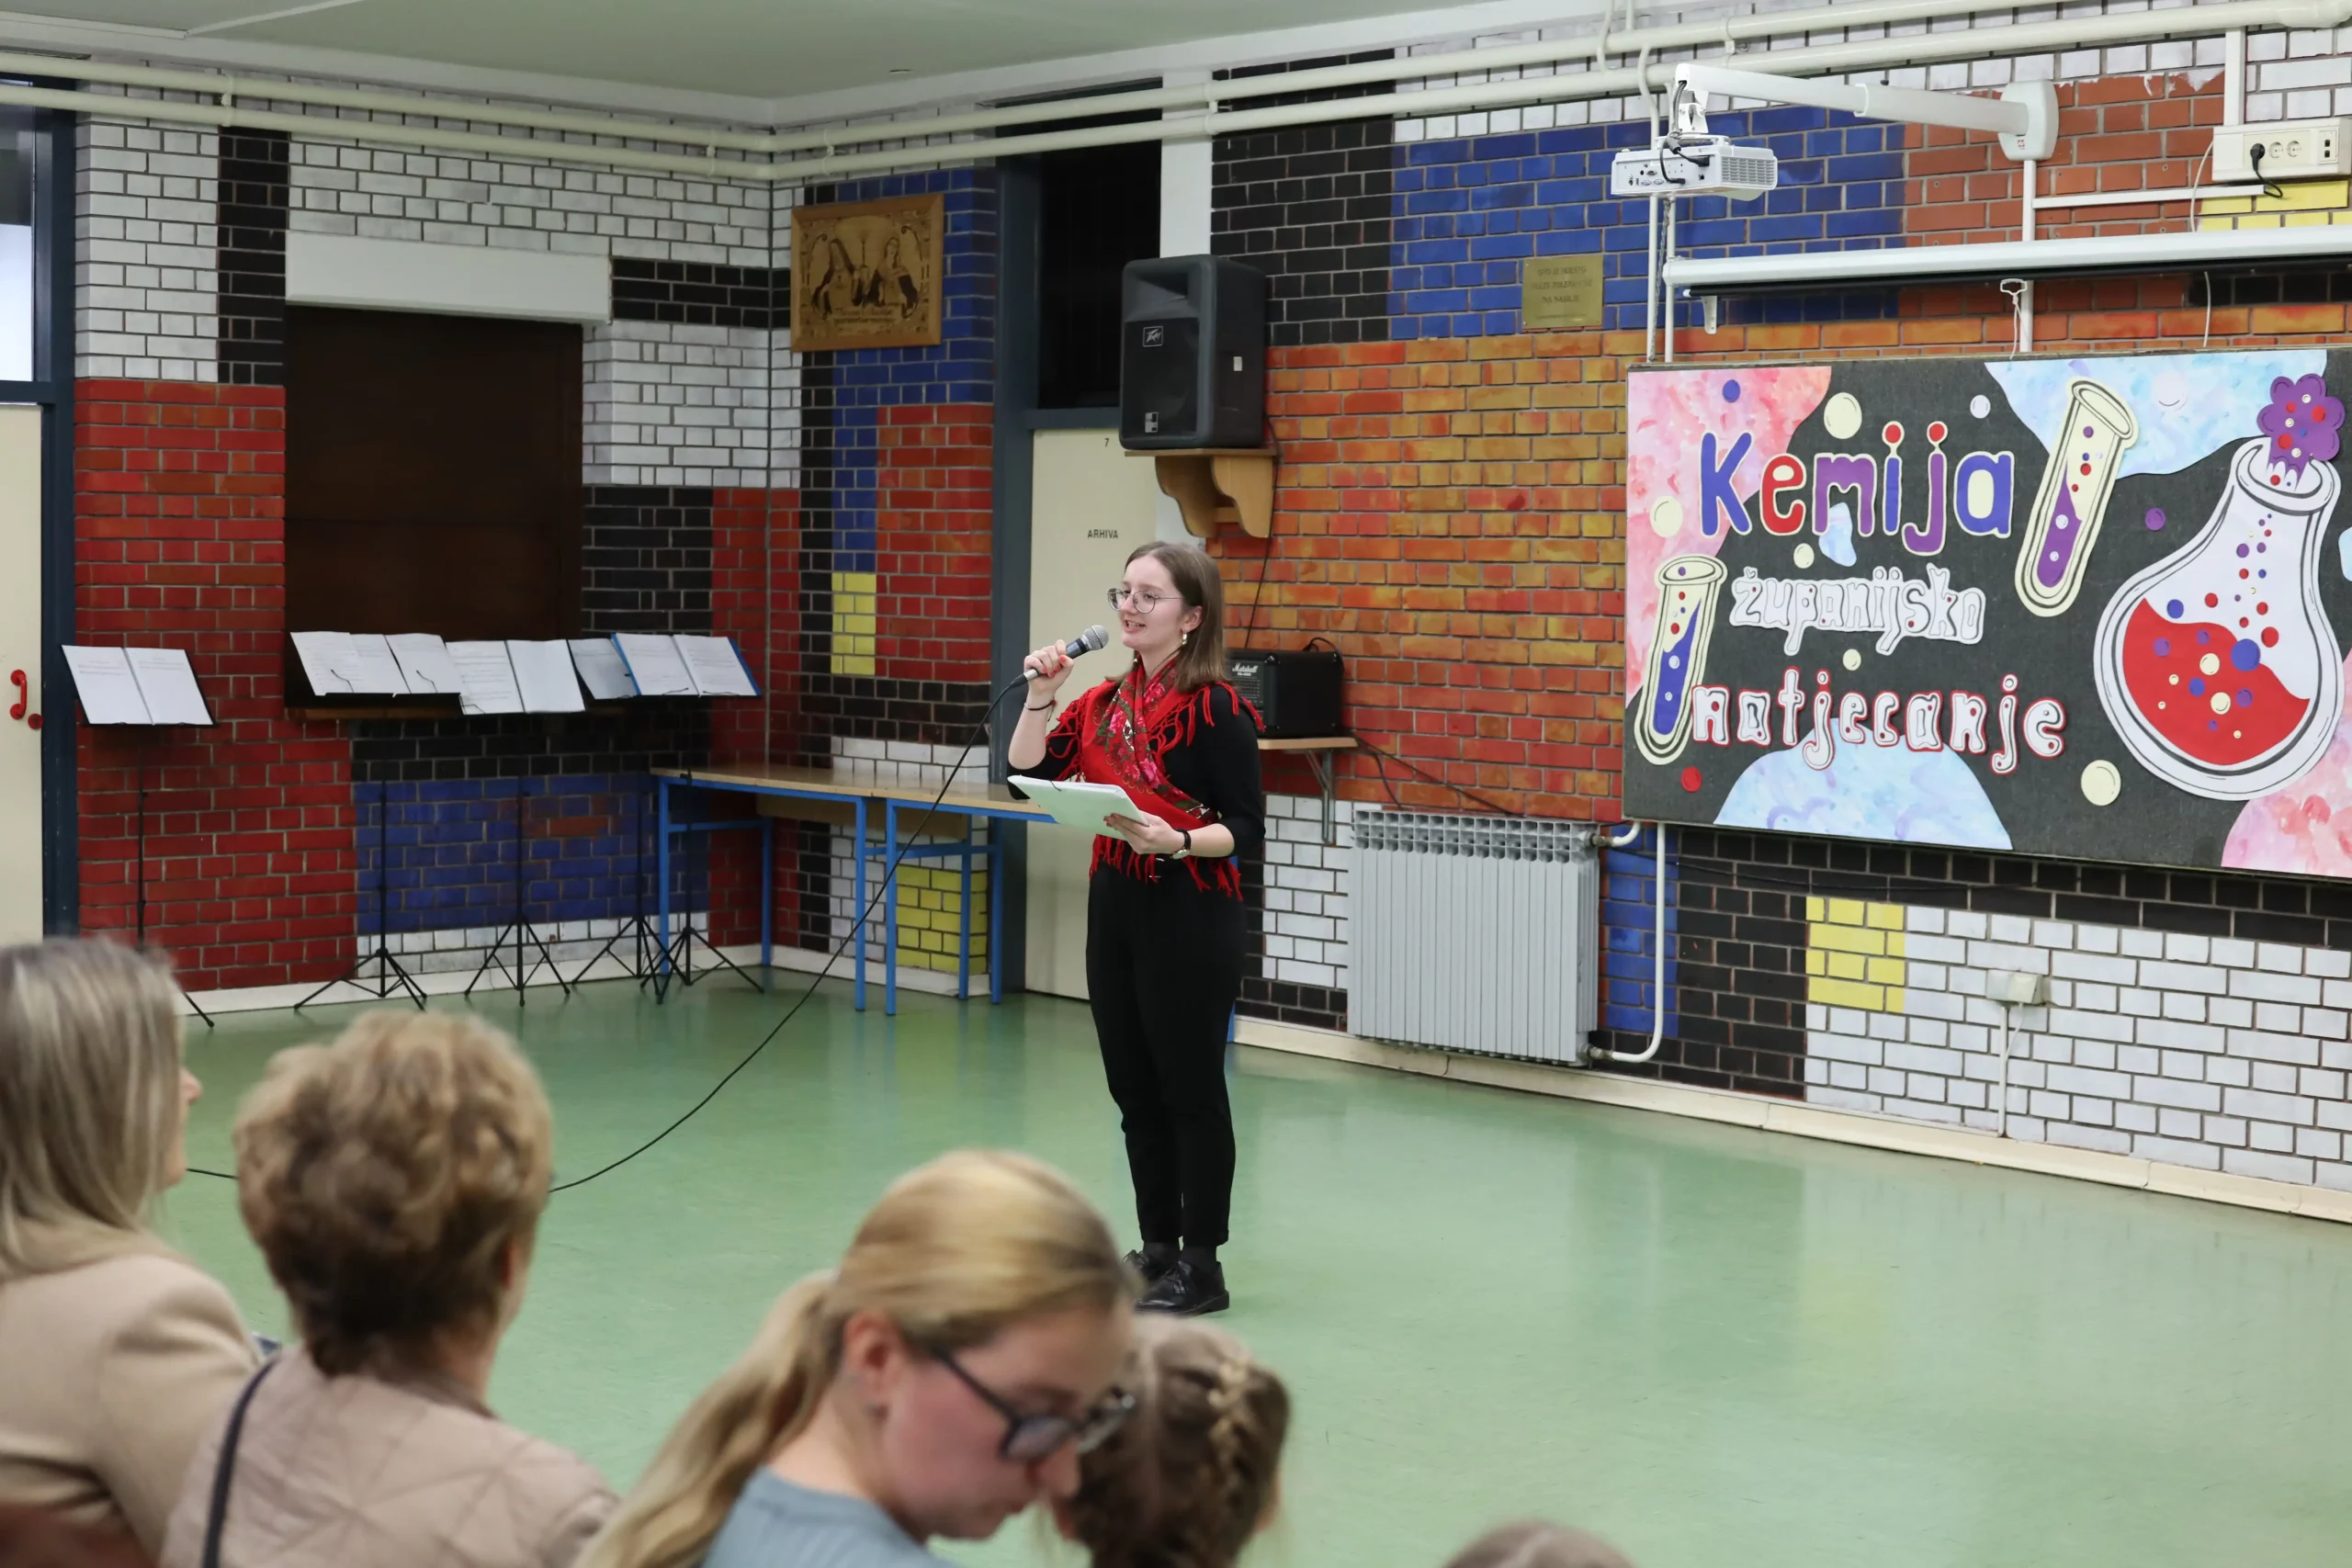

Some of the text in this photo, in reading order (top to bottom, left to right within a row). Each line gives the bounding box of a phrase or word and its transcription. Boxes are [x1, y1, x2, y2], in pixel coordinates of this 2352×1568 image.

[1104, 437, 1110, 447] 7
[1700, 421, 2015, 556] Kemija
[1087, 529, 1119, 539] ARHIVA
[1691, 667, 2066, 774] natjecanje
